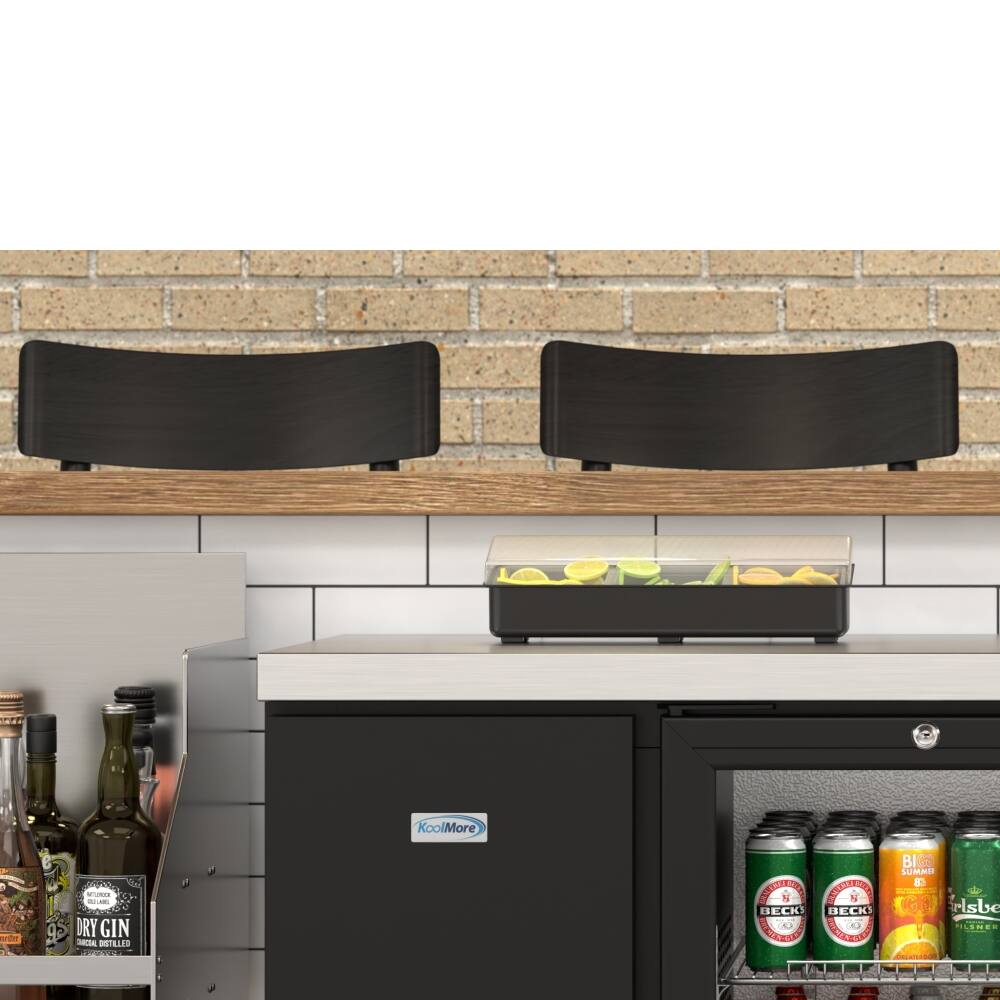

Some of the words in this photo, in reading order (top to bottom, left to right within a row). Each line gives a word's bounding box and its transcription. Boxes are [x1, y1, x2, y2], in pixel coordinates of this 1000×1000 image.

[417, 821, 476, 833] KoolMore
[759, 904, 805, 916] BECK'S
[827, 904, 873, 916] BECK'S
[76, 917, 98, 938] DRY
[100, 918, 131, 938] GIN
[100, 939, 131, 948] DISTILLED
